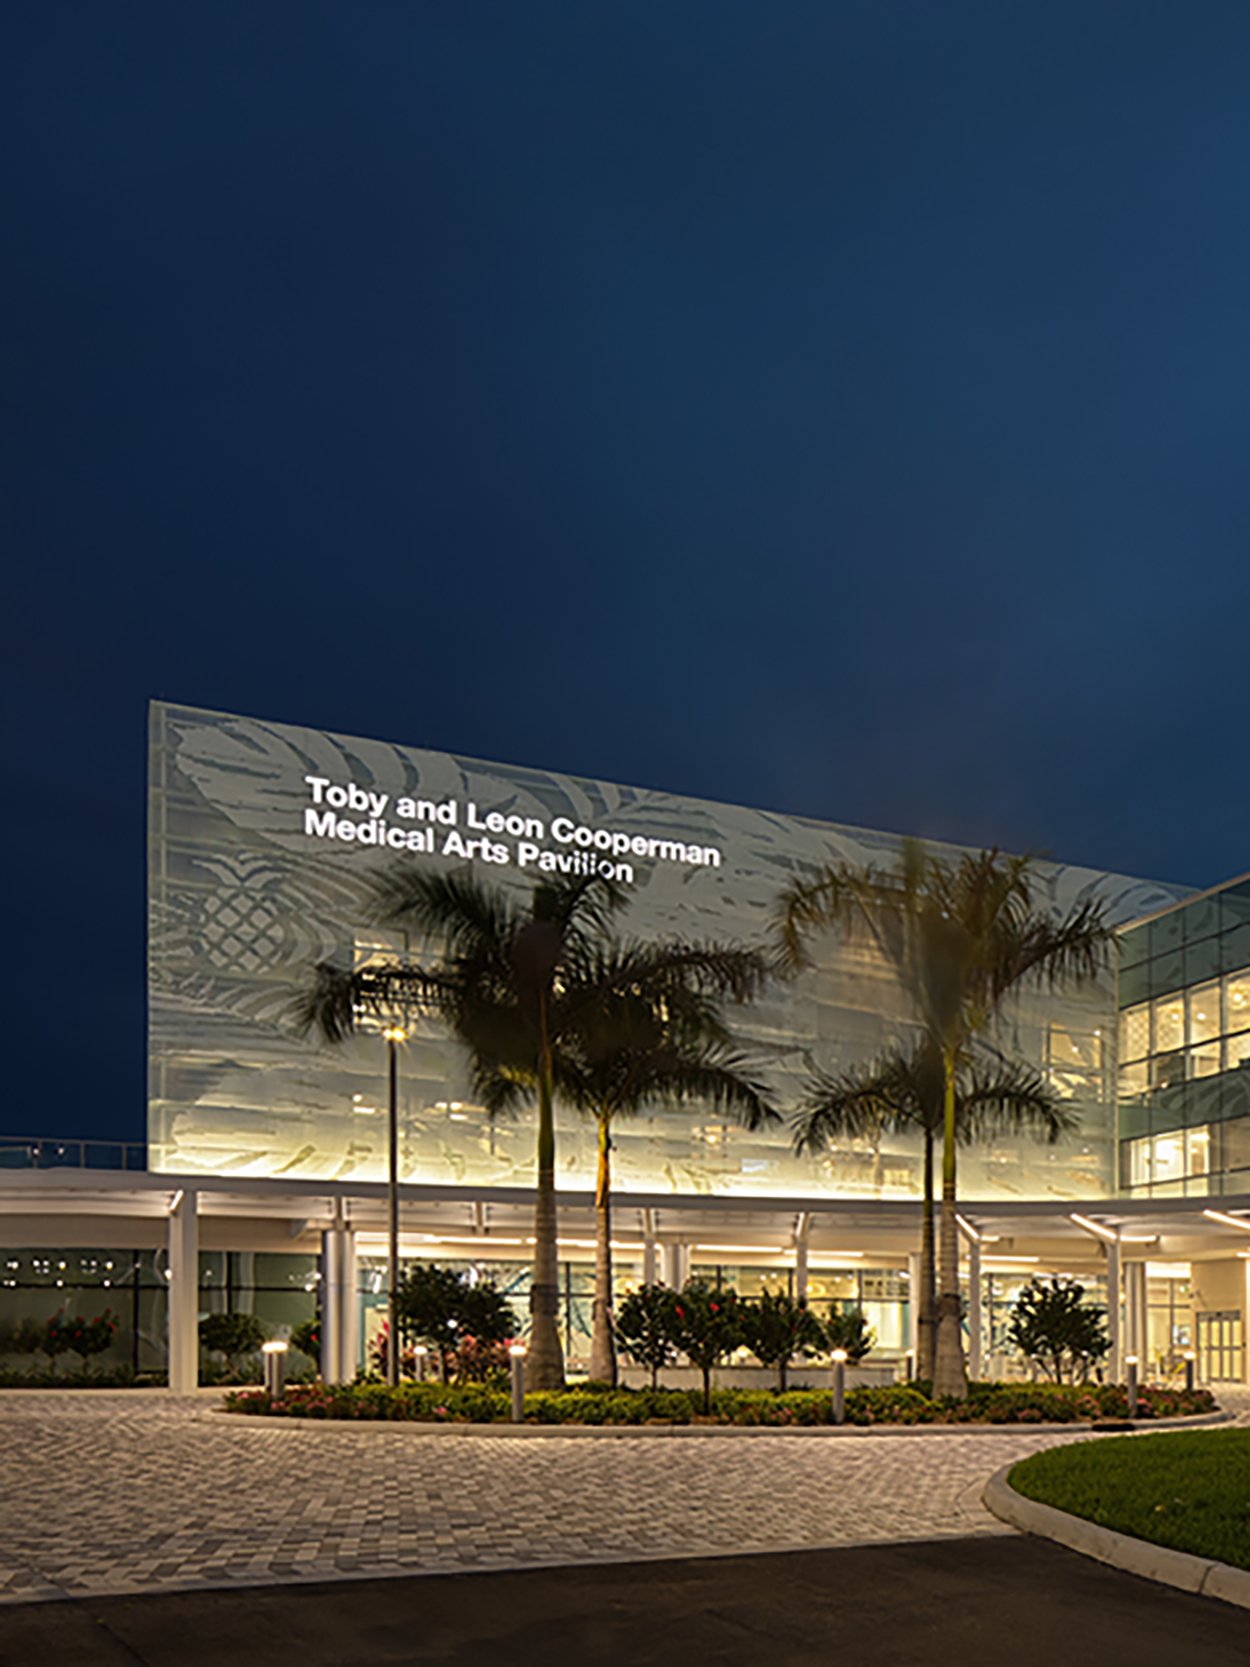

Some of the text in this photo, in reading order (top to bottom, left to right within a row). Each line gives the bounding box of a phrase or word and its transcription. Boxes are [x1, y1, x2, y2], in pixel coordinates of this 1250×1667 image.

[305, 775, 720, 867] Toby and Leon Cooperman
[305, 808, 633, 883] Medical Arts Pavilion
